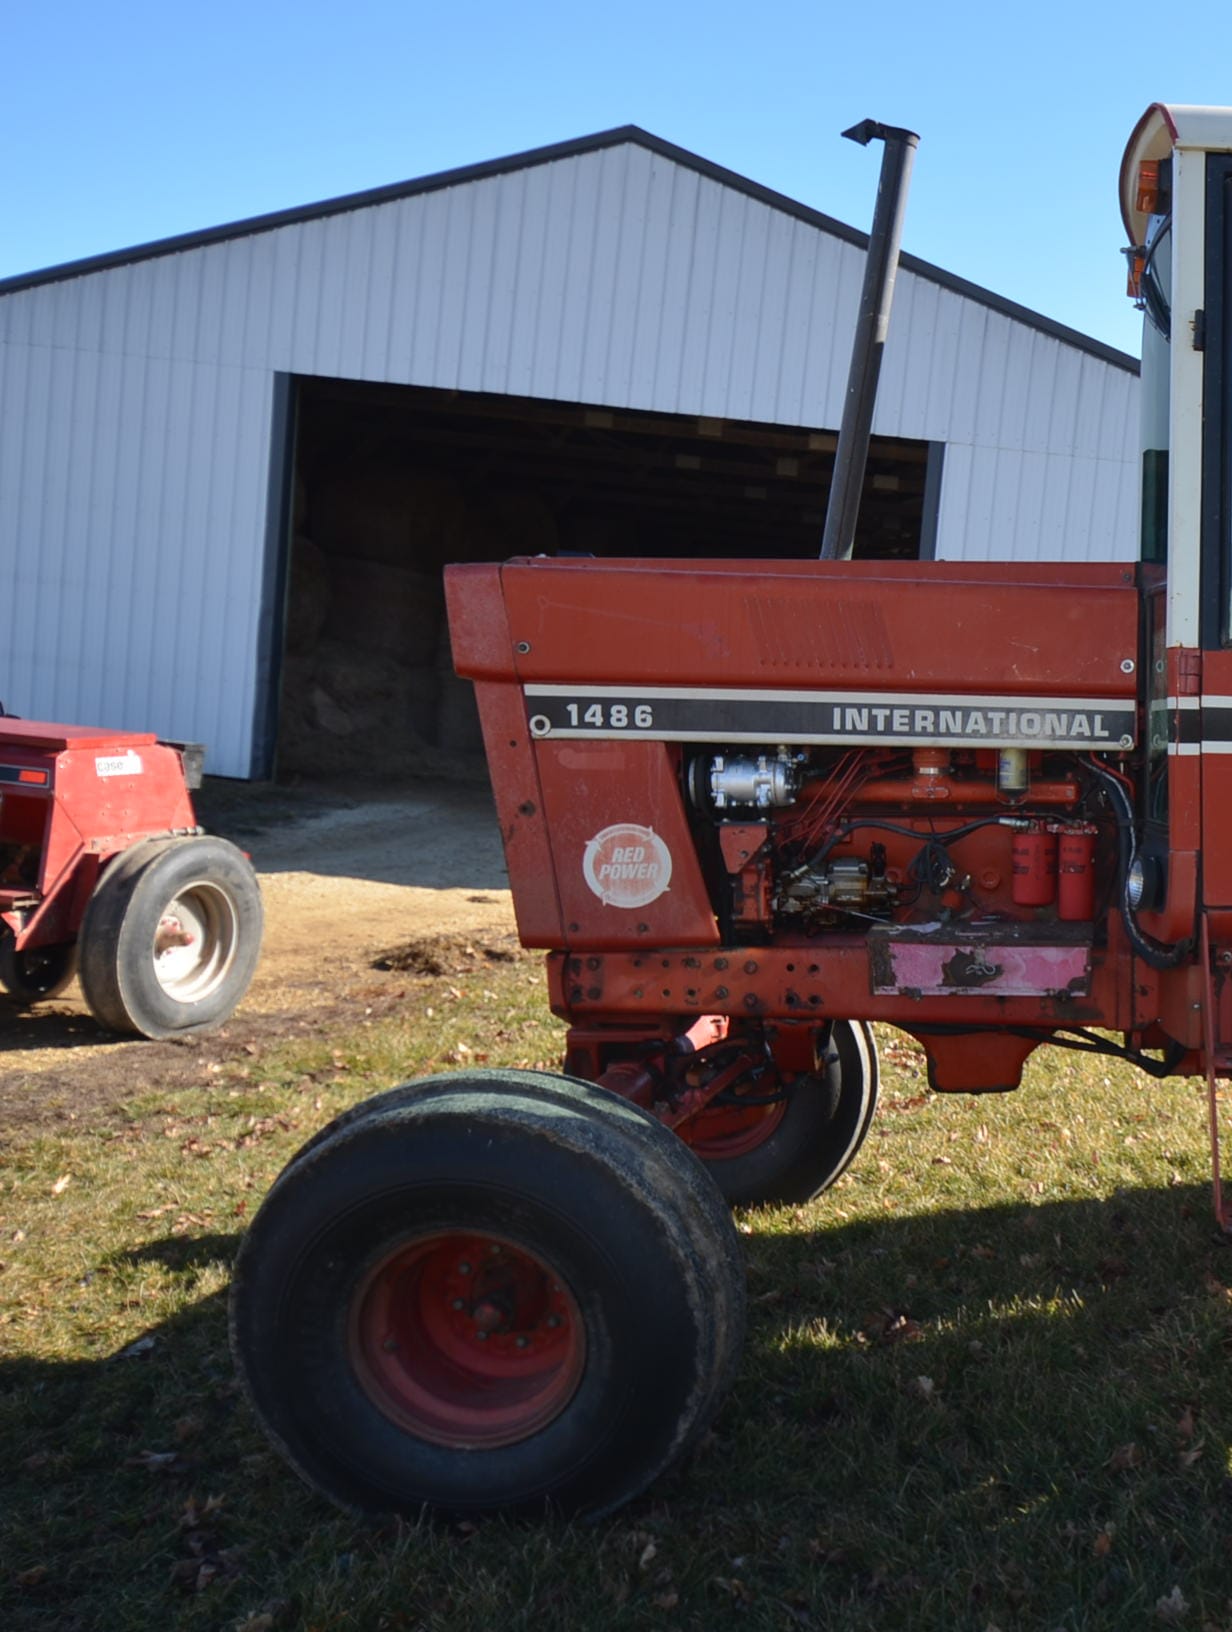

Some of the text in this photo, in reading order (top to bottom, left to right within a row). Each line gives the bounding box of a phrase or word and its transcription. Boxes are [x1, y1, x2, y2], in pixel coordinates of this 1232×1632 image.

[565, 703, 1109, 737] 1486 INTERNATIONAL
[612, 847, 645, 862] RED
[600, 863, 658, 880] POWER
